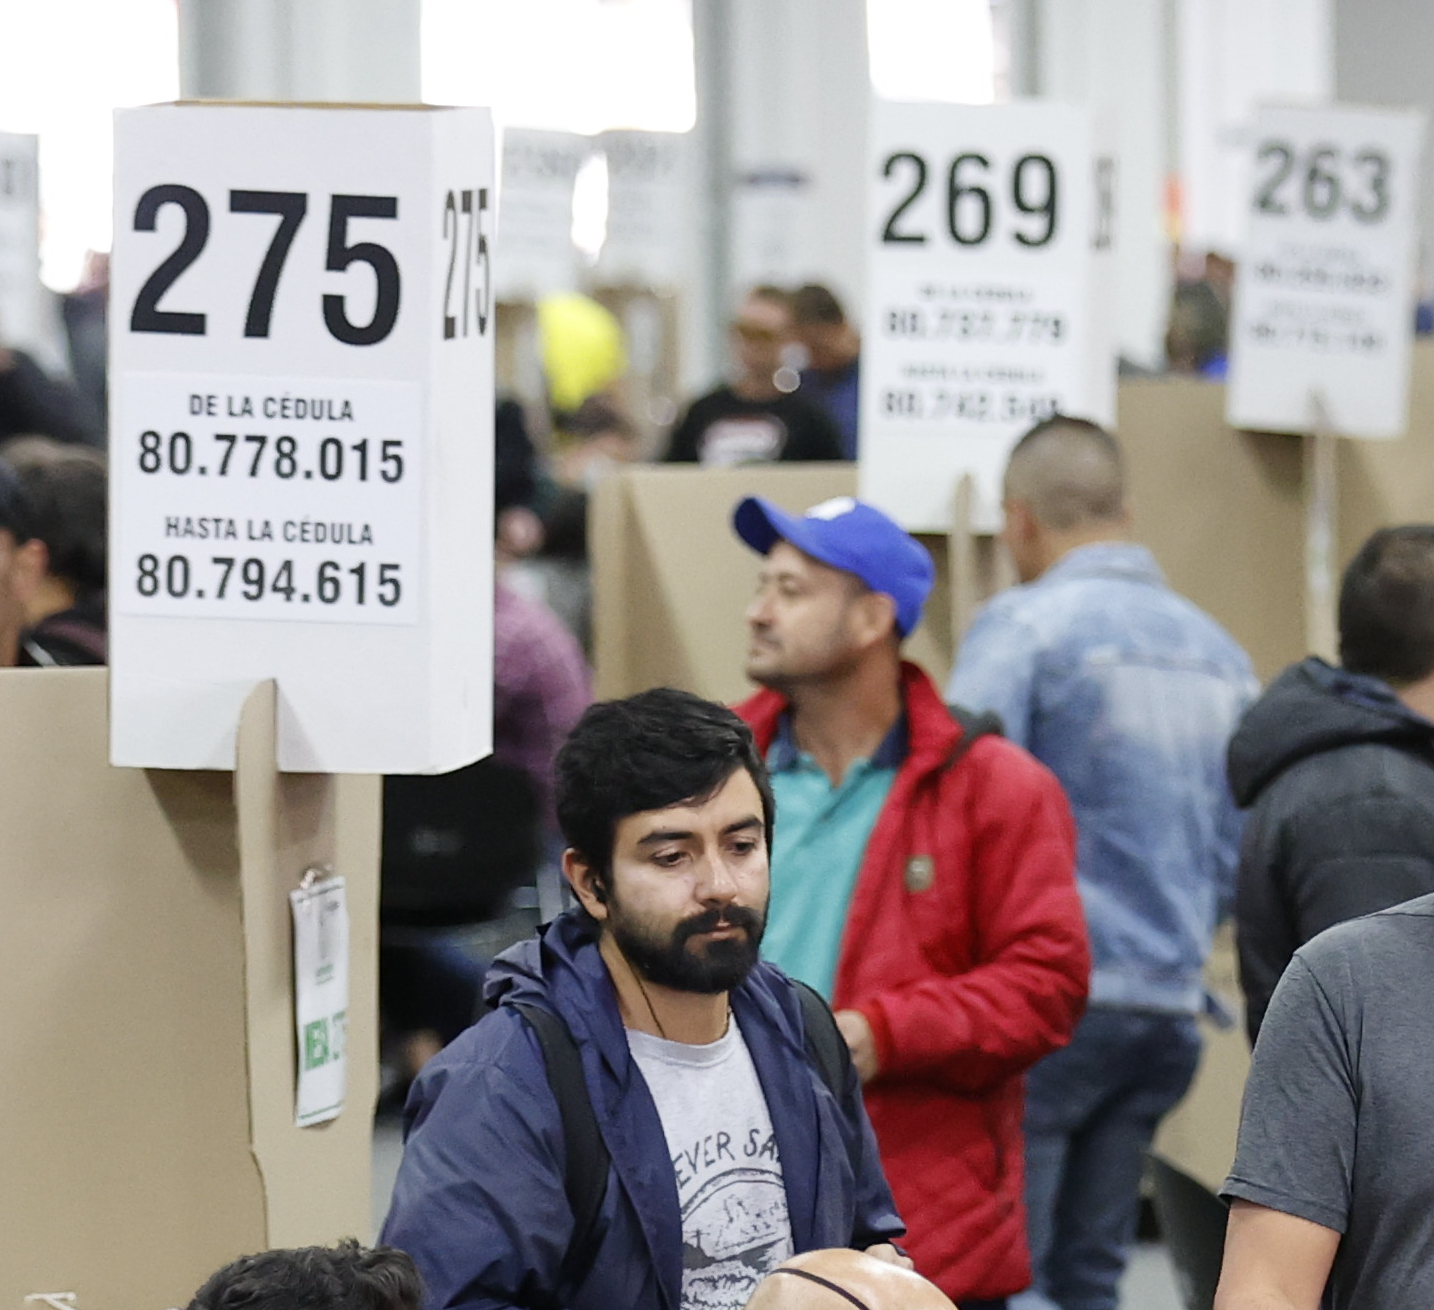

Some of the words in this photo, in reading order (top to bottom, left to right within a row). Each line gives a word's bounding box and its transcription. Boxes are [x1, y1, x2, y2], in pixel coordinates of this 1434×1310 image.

[882, 151, 1058, 248] 269
[1255, 142, 1392, 224] 263
[130, 183, 402, 348] 275
[441, 188, 490, 342] 275
[189, 393, 218, 416] DE
[227, 396, 254, 418] LA
[263, 393, 354, 422] CÉDULA
[138, 429, 405, 484] 80.778.015
[165, 516, 237, 540] HASTA
[247, 519, 273, 542] LA
[283, 515, 373, 545] CÉDULA
[136, 553, 402, 607] 80.794.615
[674, 1131, 736, 1190] EVER
[744, 1128, 780, 1163] SA
